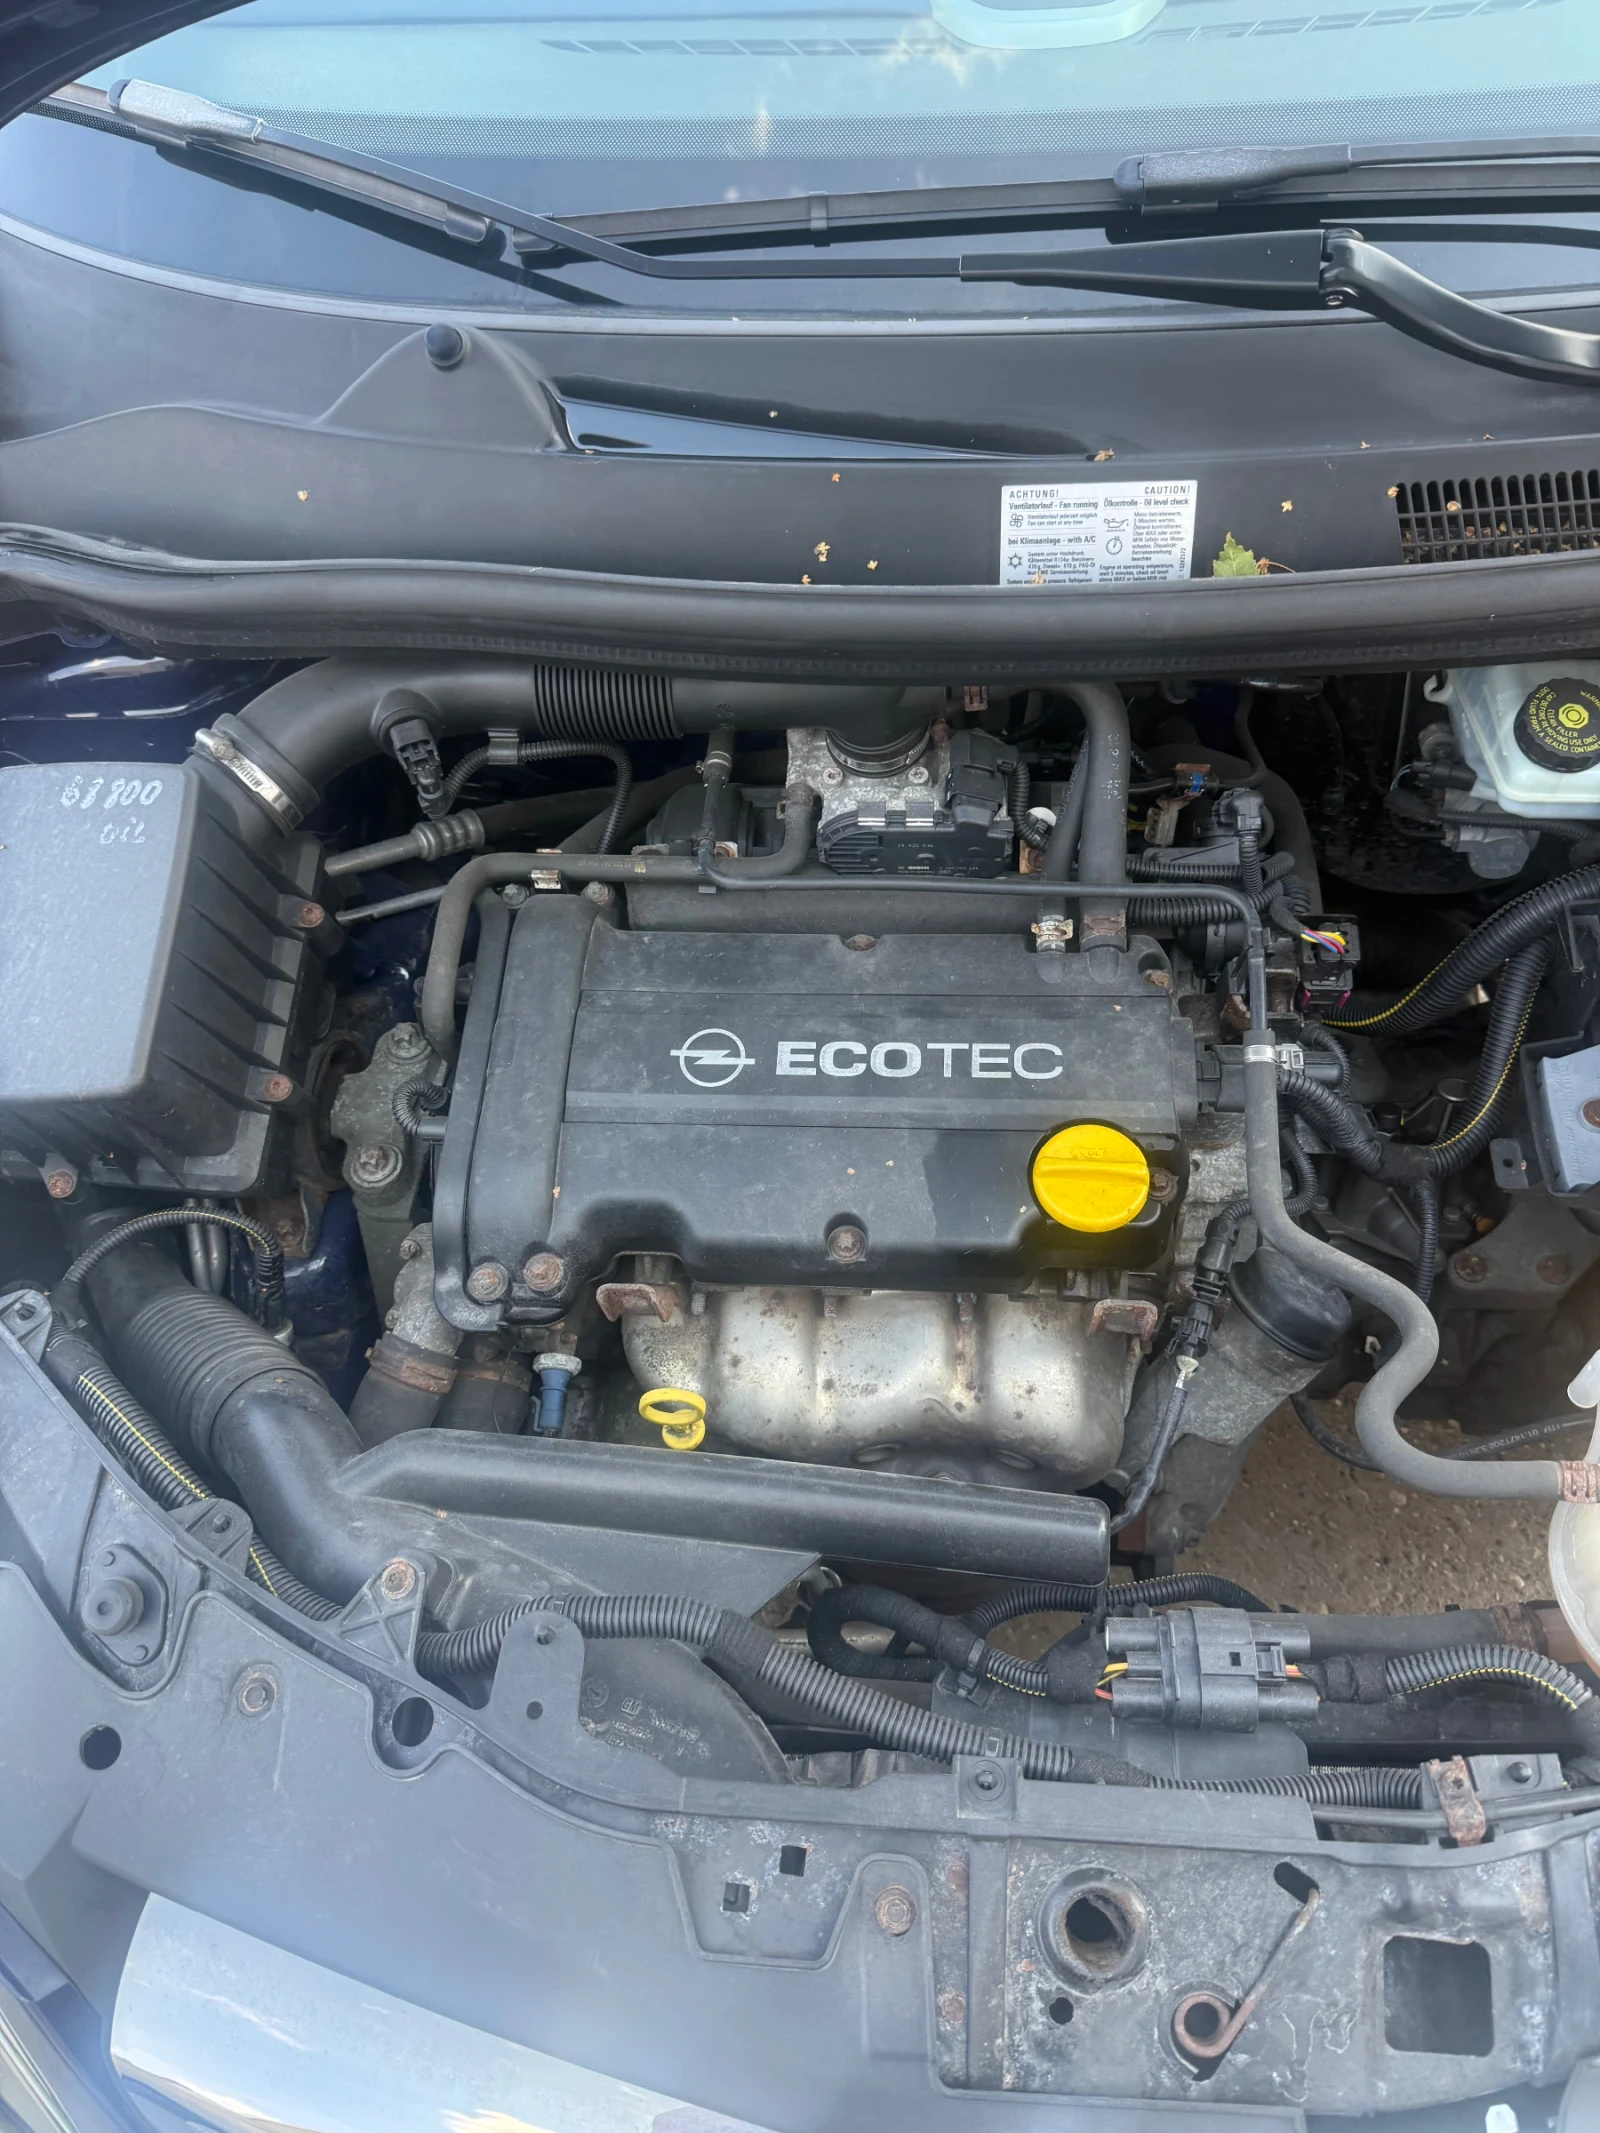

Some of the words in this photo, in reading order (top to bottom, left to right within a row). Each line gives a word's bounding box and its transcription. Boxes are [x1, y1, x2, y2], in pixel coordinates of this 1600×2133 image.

[1009, 488, 1059, 499] ACHTUNG!
[1144, 485, 1191, 495] CAUTION!
[1008, 501, 1053, 510] Ventilatorlauf
[1059, 501, 1072, 509] Fan
[1073, 500, 1099, 510] running
[1103, 498, 1138, 507] Ölkontrolle
[1144, 498, 1152, 507] Oil
[1153, 497, 1169, 506] level
[1169, 497, 1189, 506] check
[1008, 537, 1019, 545] bei
[1019, 536, 1061, 546] Klimaanlage
[1067, 536, 1082, 544] with
[1083, 535, 1096, 543] A/C
[1545, 691, 1557, 702] CAP
[1528, 699, 1539, 715] FLUID
[1538, 700, 1549, 721] BEFORE
[1529, 716, 1542, 733] FROM
[1547, 709, 1558, 727] CLEAN
[1555, 726, 1579, 738] FILLER
[1541, 720, 1569, 744] REMOVING
[1582, 733, 1598, 745] ONLY
[1543, 736, 1569, 752] SEALED
[1569, 738, 1583, 746] USE
[775, 1040, 1064, 1081] ECOTEC
[622, 1697, 642, 1715] GM
